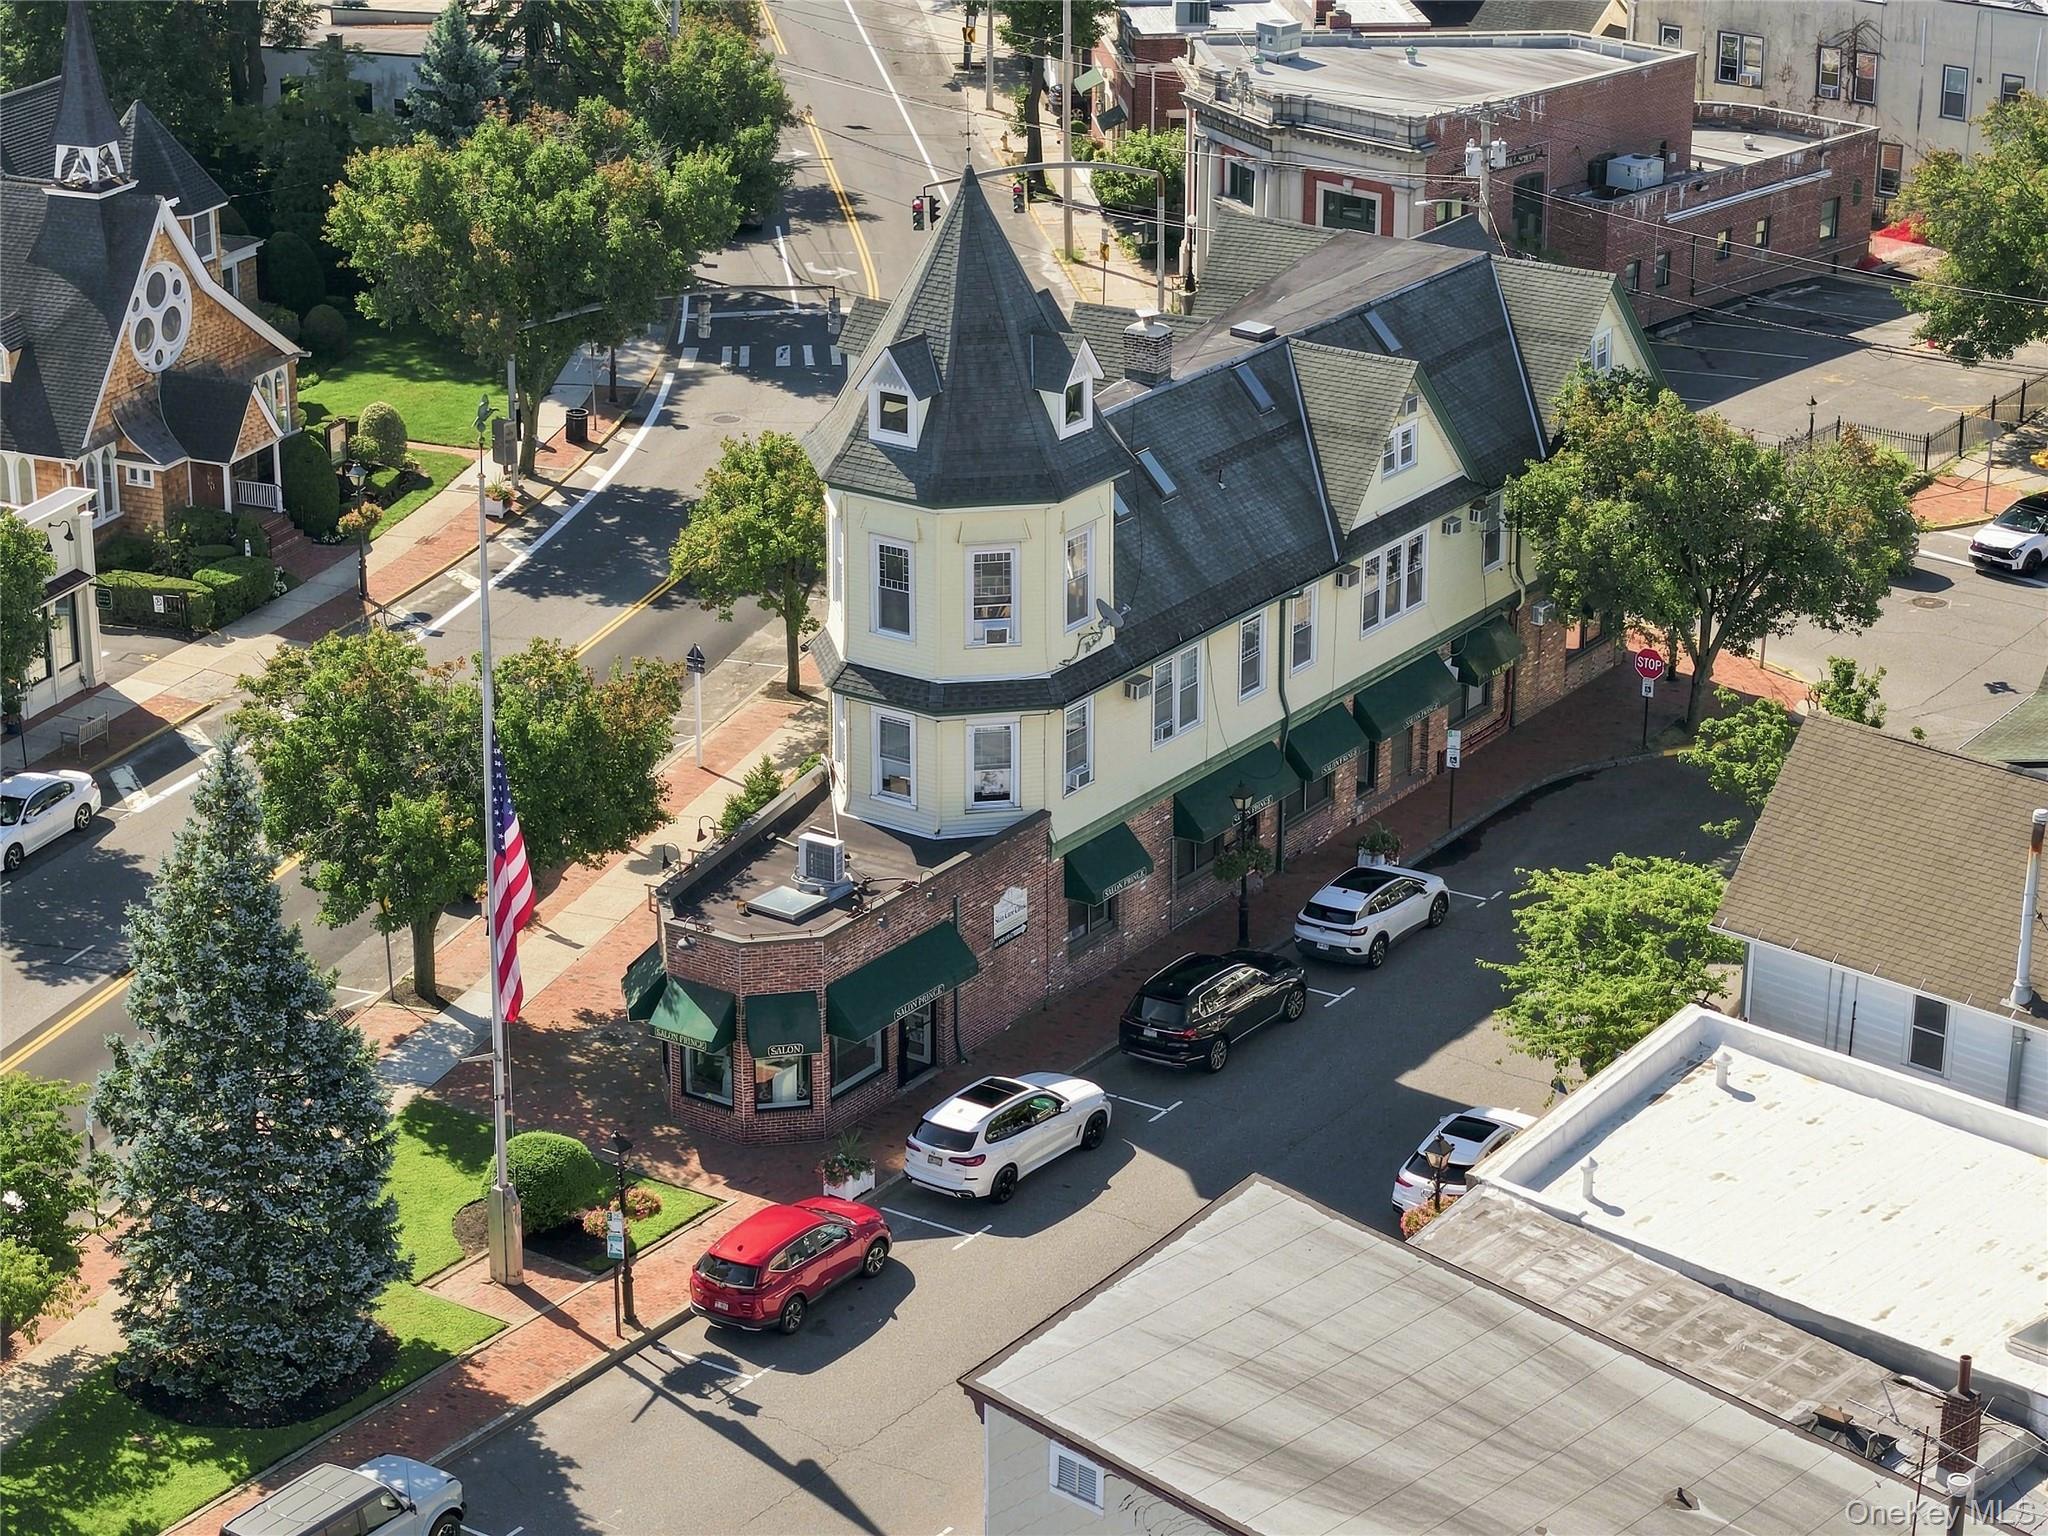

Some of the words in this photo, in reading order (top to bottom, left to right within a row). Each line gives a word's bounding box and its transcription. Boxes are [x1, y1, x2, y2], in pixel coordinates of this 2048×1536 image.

[1637, 656, 1662, 671] STOP
[1104, 882, 1123, 898] SALON
[896, 999, 918, 1018] SALON
[656, 1028, 678, 1042] SALON
[770, 1045, 801, 1055] SALON
